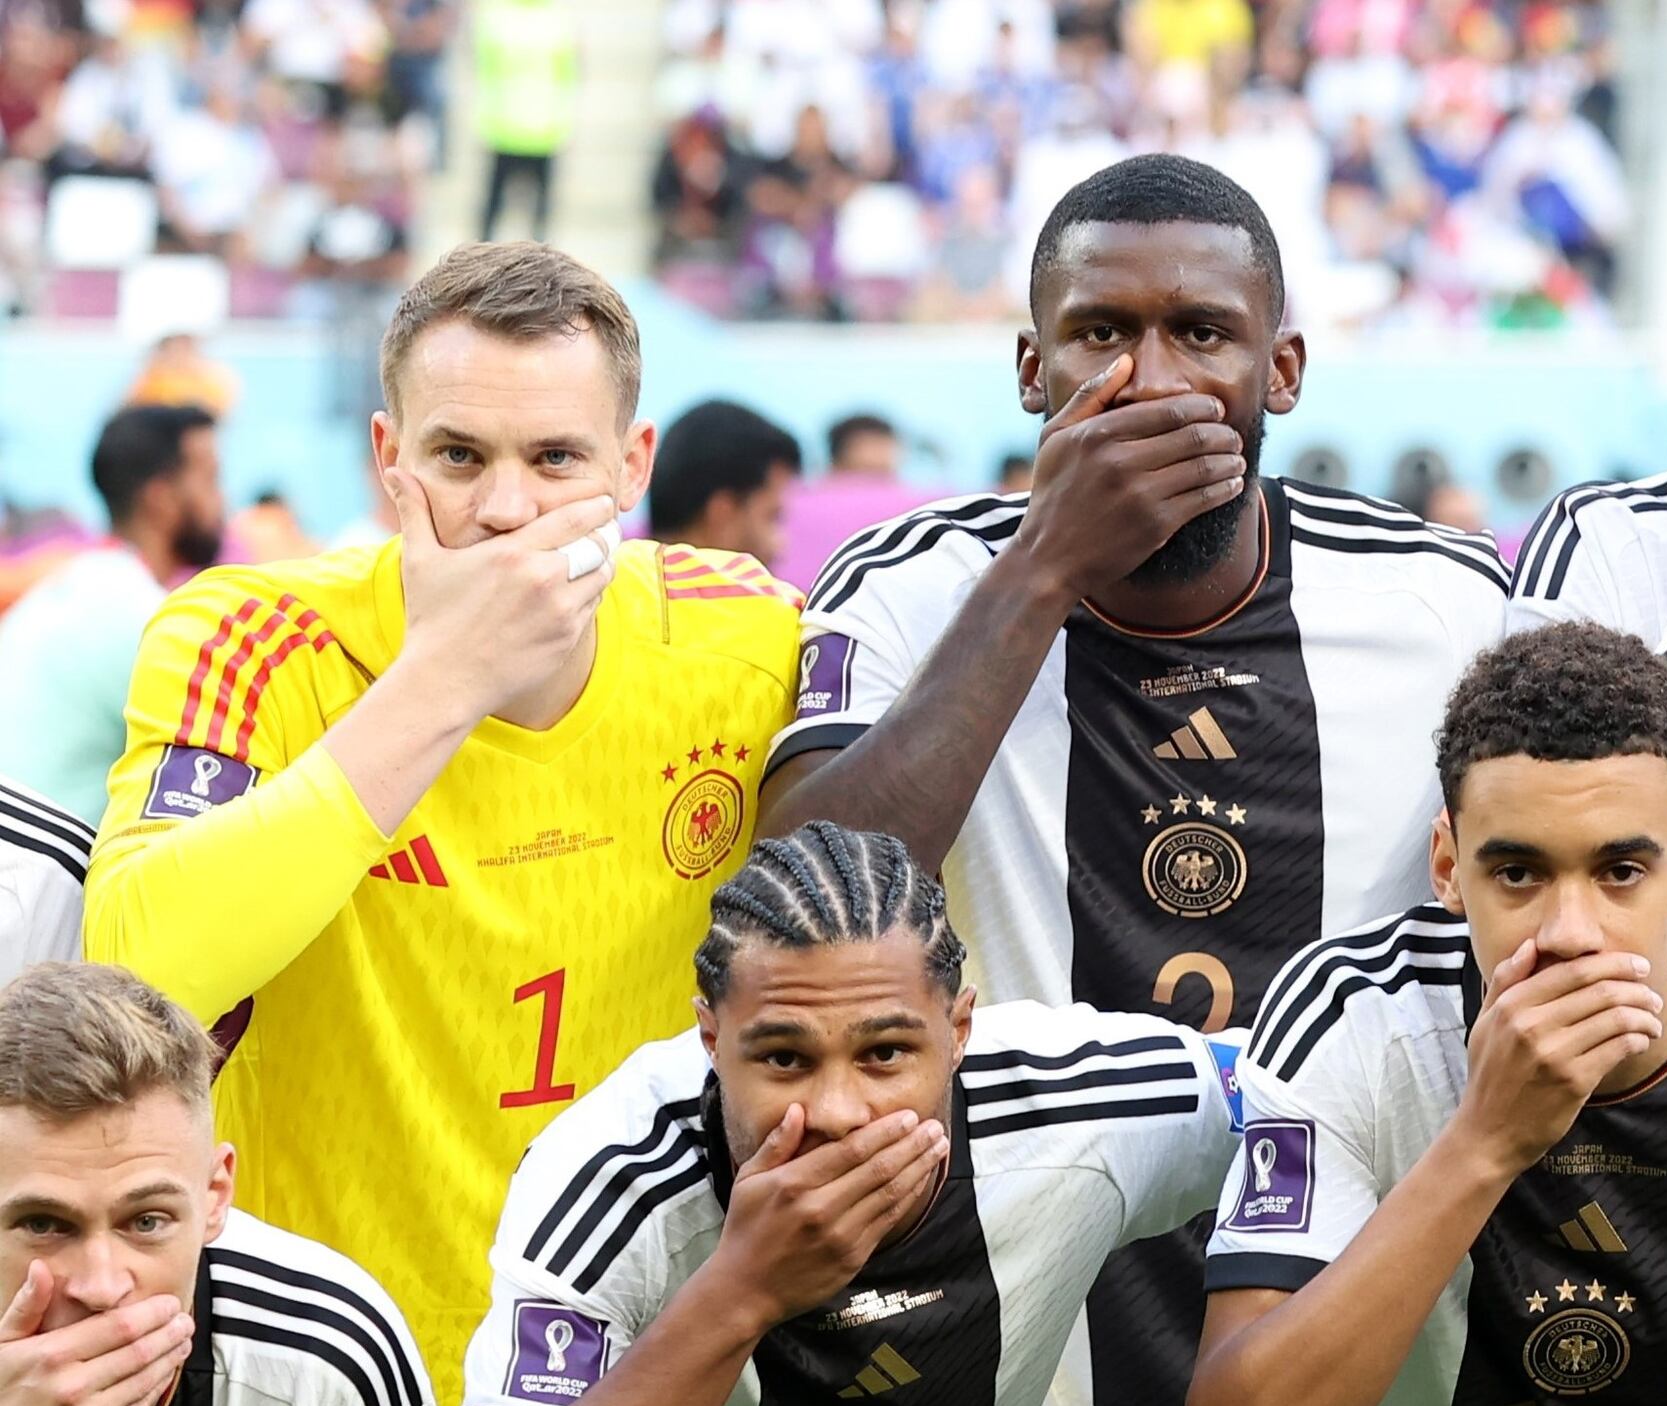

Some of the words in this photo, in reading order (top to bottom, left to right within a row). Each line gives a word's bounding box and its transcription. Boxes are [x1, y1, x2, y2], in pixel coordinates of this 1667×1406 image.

[1154, 673, 1199, 688] NOVEMBER
[1201, 666, 1226, 680] 2022
[1149, 681, 1219, 697] INTERNATIONAL
[535, 828, 562, 841] JAPAN
[477, 855, 515, 868] KHALIFA
[518, 845, 580, 864] INTERNATIONAL
[583, 835, 614, 851] STADIUM
[508, 845, 520, 855] 23
[522, 839, 566, 853] NOVEMBER
[568, 832, 587, 845] 2022
[1165, 835, 1224, 854] DEUTSCHER
[499, 968, 575, 1109] 1
[1571, 1144, 1603, 1154] JAPAN
[1557, 1154, 1606, 1166] NOVEMBER
[1609, 1155, 1633, 1165] 2022
[1551, 1163, 1624, 1176] INTERNATIONAL
[1626, 1165, 1667, 1177] STADIUM
[904, 1288, 944, 1311] STADIUM
[538, 1375, 570, 1387] WORLD
[570, 1378, 589, 1390] CUP
